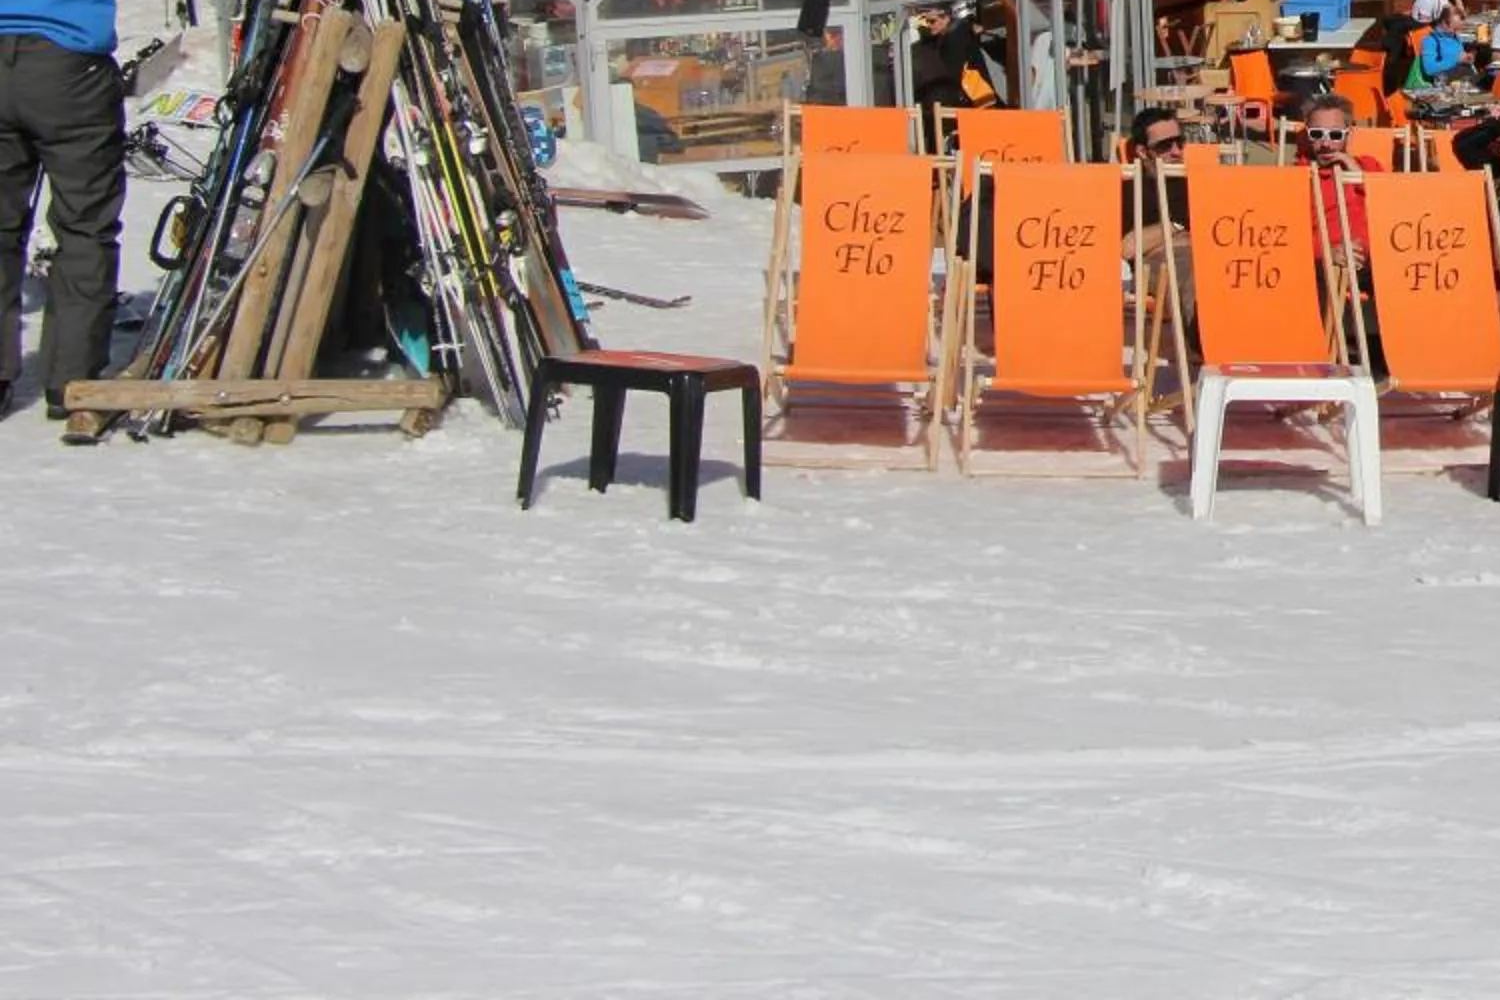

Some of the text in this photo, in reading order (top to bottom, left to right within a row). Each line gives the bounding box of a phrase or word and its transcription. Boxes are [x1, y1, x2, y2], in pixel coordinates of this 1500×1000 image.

[824, 193, 906, 235] Chez
[1016, 208, 1096, 249] Chez
[1211, 210, 1289, 248] Chez
[1390, 213, 1466, 252] Chez
[835, 236, 894, 276] Flo
[1028, 250, 1085, 290] Flo
[1225, 251, 1281, 289] Flo
[1405, 252, 1460, 291] Flo
